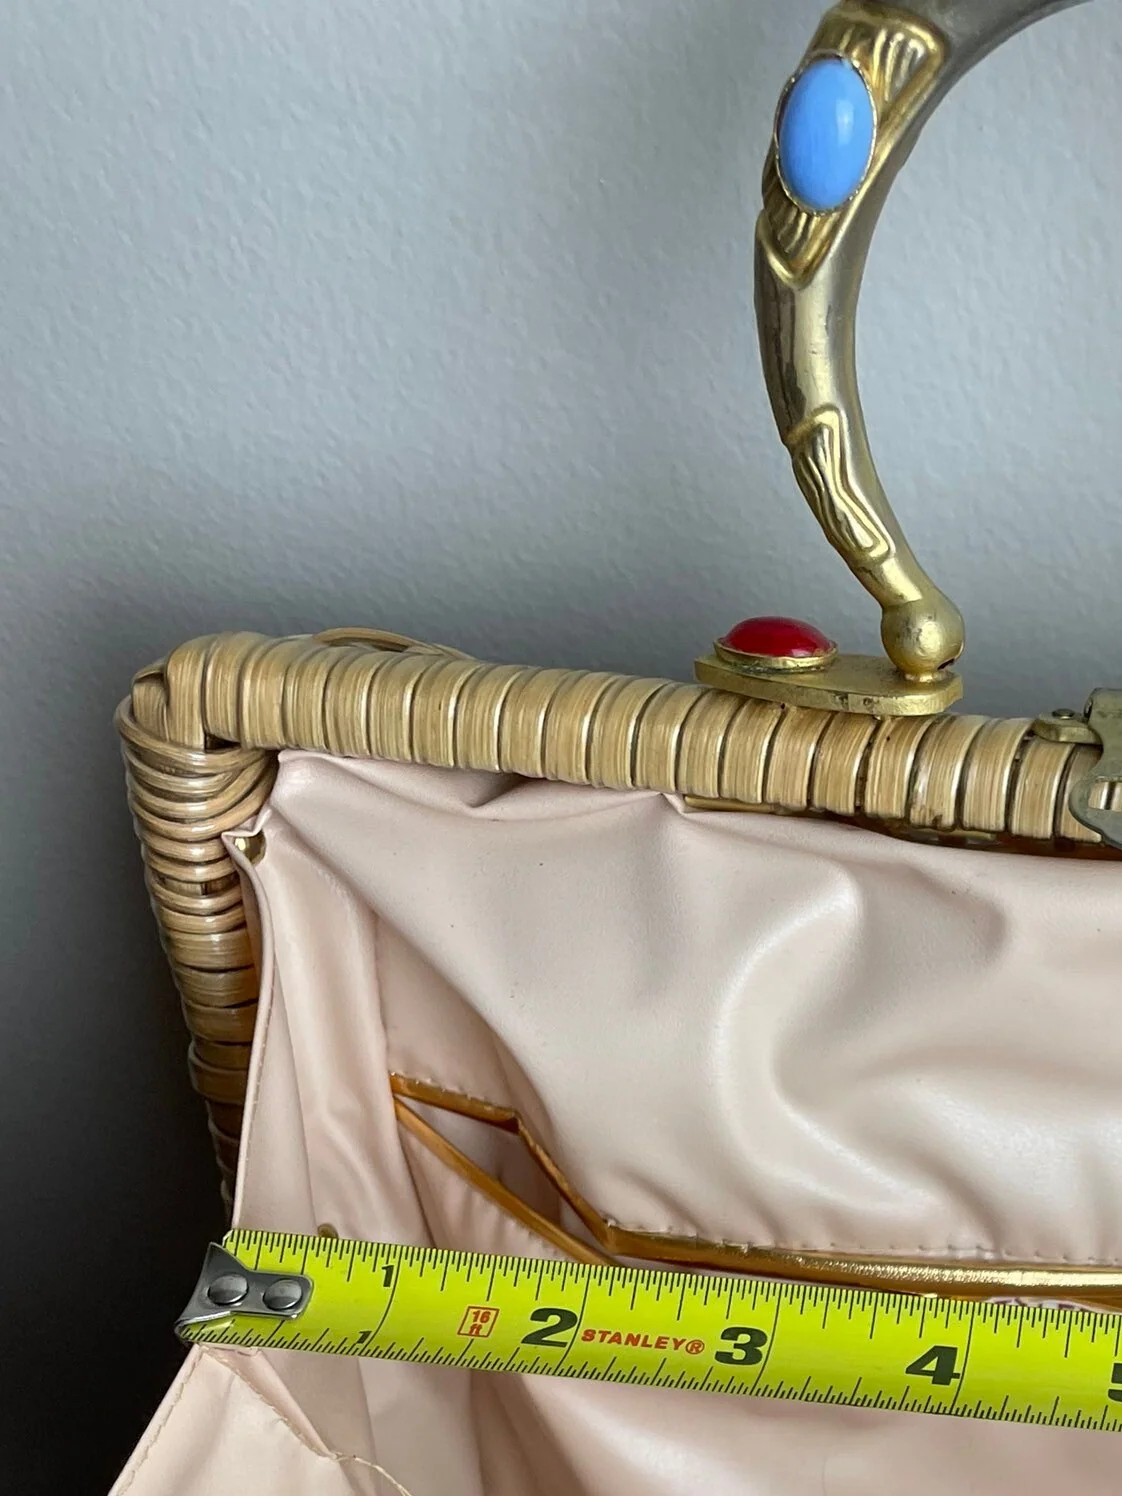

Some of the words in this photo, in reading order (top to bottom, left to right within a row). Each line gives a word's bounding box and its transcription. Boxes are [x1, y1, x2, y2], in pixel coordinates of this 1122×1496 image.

[381, 1264, 396, 1288] 1
[468, 1323, 483, 1336] ft
[472, 1309, 491, 1324] 16
[521, 1307, 578, 1348] 2
[714, 1326, 768, 1366] 3
[905, 1345, 961, 1386] 4
